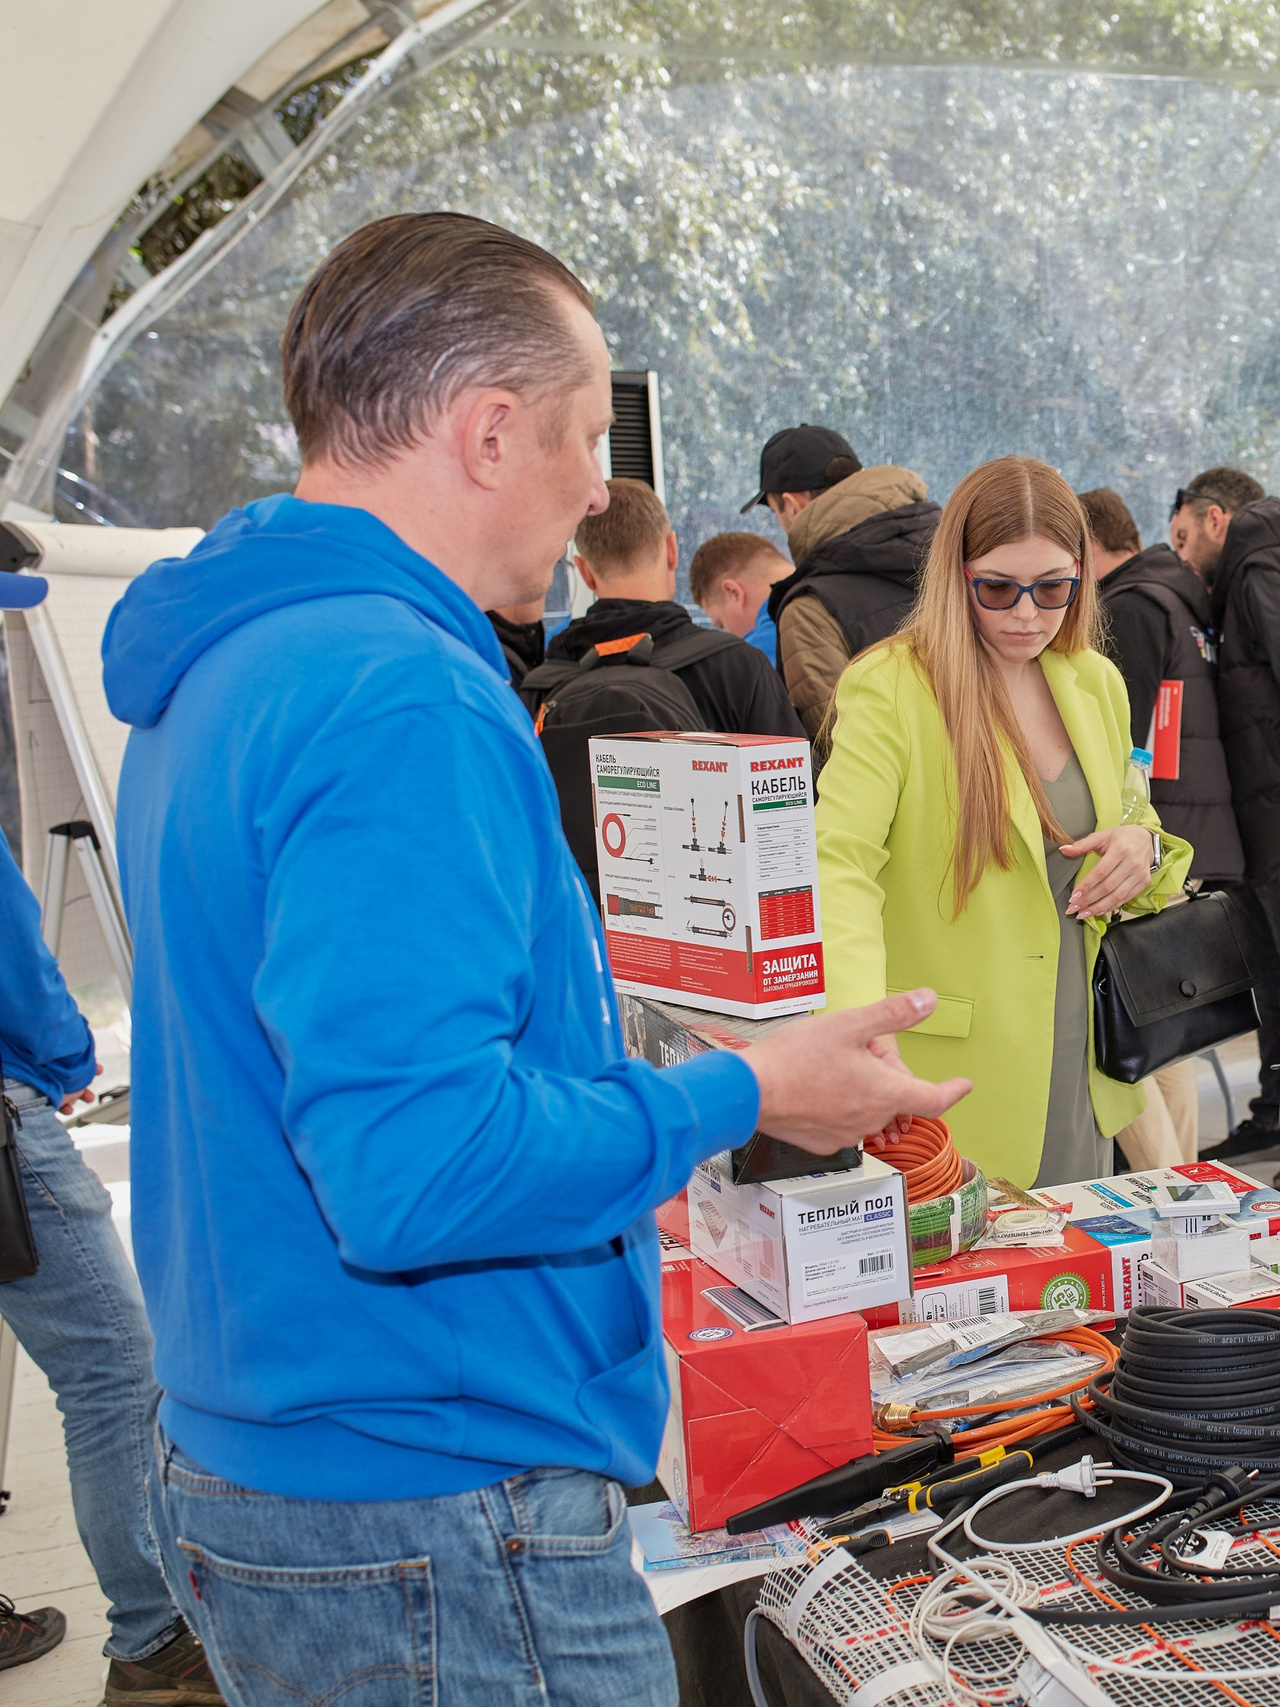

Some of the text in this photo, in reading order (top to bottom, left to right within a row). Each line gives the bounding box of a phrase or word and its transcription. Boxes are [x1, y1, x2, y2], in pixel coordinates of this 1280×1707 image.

[595, 754, 617, 764] КАБЕЛЬ
[750, 756, 804, 773] REXANT
[596, 765, 660, 778] САМОРЕГУЛИРУЮЩИЙСЯ
[691, 760, 729, 773] REXANT
[637, 780, 657, 790] ECO LINE
[751, 775, 806, 795] КАБЕЛЬ
[752, 792, 808, 803] САМОРЕГУЛИРУЮЩИЙСЯ
[762, 953, 818, 975] ЗАЩИТА
[763, 970, 818, 986] ОТ ЗАМЕРЗАНИЯ
[763, 978, 819, 993] БЫТОВЫХ ТРУБОПРОВОДОВ
[759, 1203, 775, 1219] REXANT
[797, 1195, 893, 1225] ТЕПЛЫЙ ПОЛ
[798, 1217, 851, 1232] НАГРЕВАТЕЛЬНЫЙ
[852, 1215, 863, 1223] МАТ
[865, 1210, 892, 1221] CLASSIC
[1121, 1257, 1132, 1310] REXANT
[1053, 1291, 1070, 1309] 25
[1063, 1287, 1078, 1304] ЛЕТ
[926, 1311, 933, 1320] Вт
[1222, 1336, 1244, 1344] 11.2020
[1212, 1411, 1239, 1419] КАБЕЛЬ
[1206, 1424, 1230, 1433] 11.2020
[1232, 1426, 1265, 1437] (51-0625)
[1168, 1453, 1240, 1467] САМОРЕГУЛИРУЕМЫЙ
